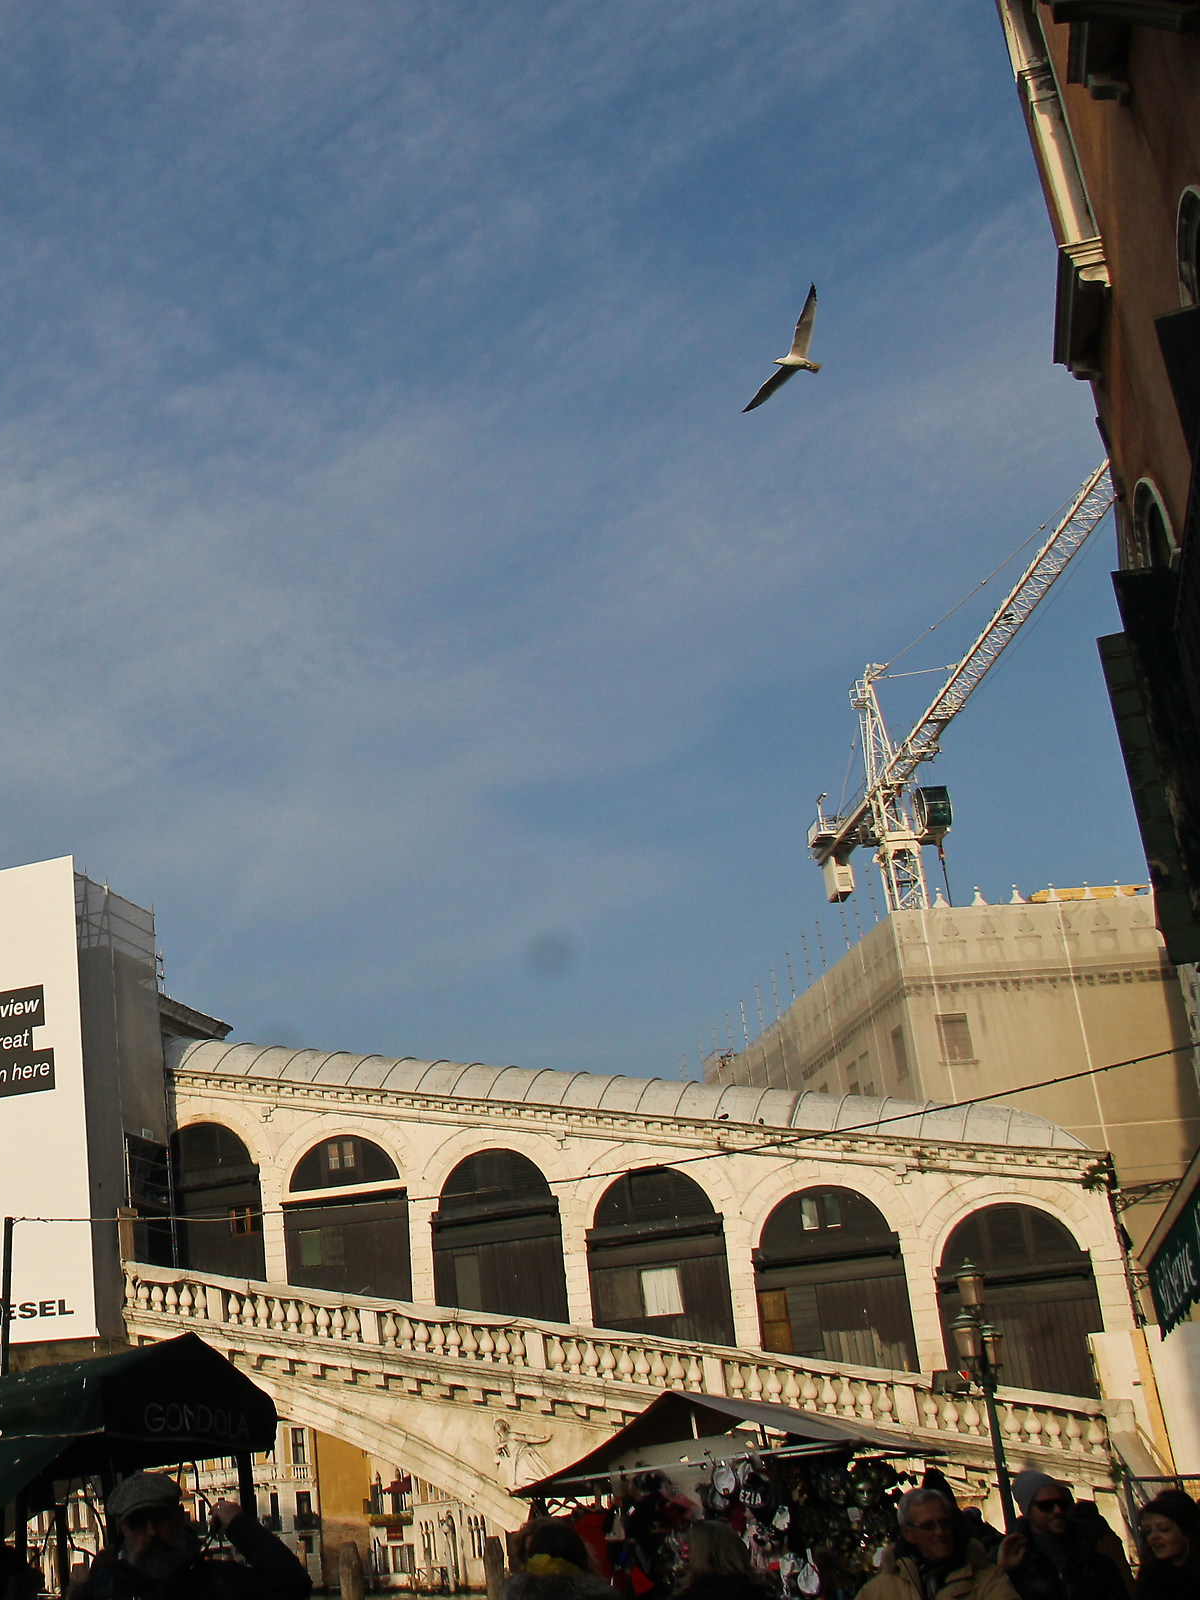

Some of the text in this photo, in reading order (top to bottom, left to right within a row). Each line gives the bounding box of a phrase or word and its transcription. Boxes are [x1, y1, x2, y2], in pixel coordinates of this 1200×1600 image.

[0, 998, 40, 1018] view
[12, 1062, 50, 1081] here
[144, 1402, 249, 1441] GONDOLA
